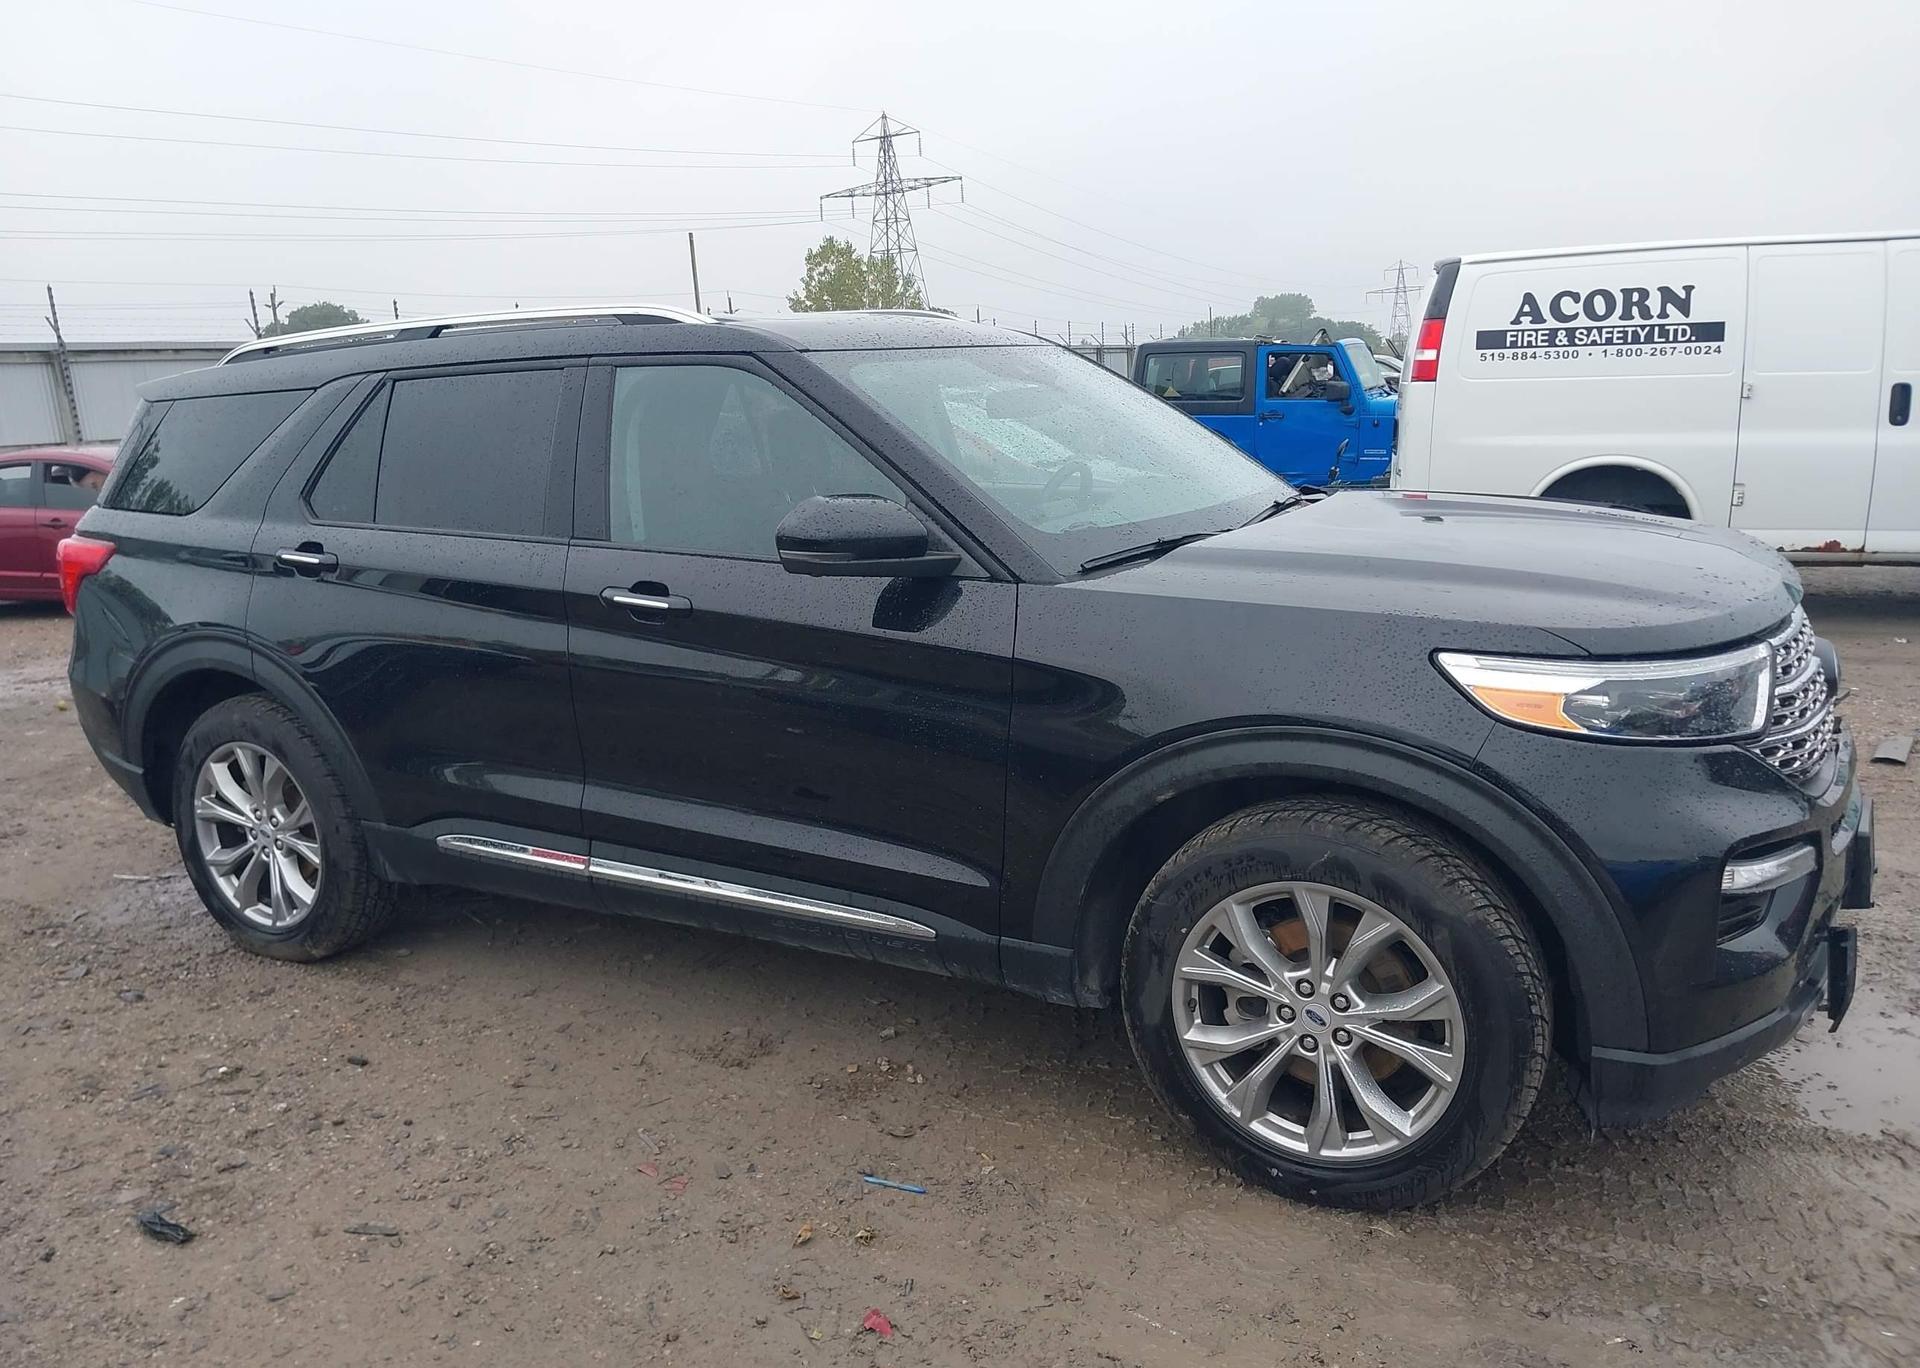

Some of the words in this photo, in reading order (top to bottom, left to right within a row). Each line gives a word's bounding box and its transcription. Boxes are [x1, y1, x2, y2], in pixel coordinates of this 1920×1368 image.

[1509, 285, 1696, 326] ACORN
[1505, 329, 1551, 348] FIRE
[1555, 329, 1569, 346] &
[1574, 326, 1650, 345] SAFETY
[1653, 325, 1696, 343] LTD.
[1479, 349, 1580, 362] 519-884-5300
[1600, 345, 1723, 358] 1-800-267-0024
